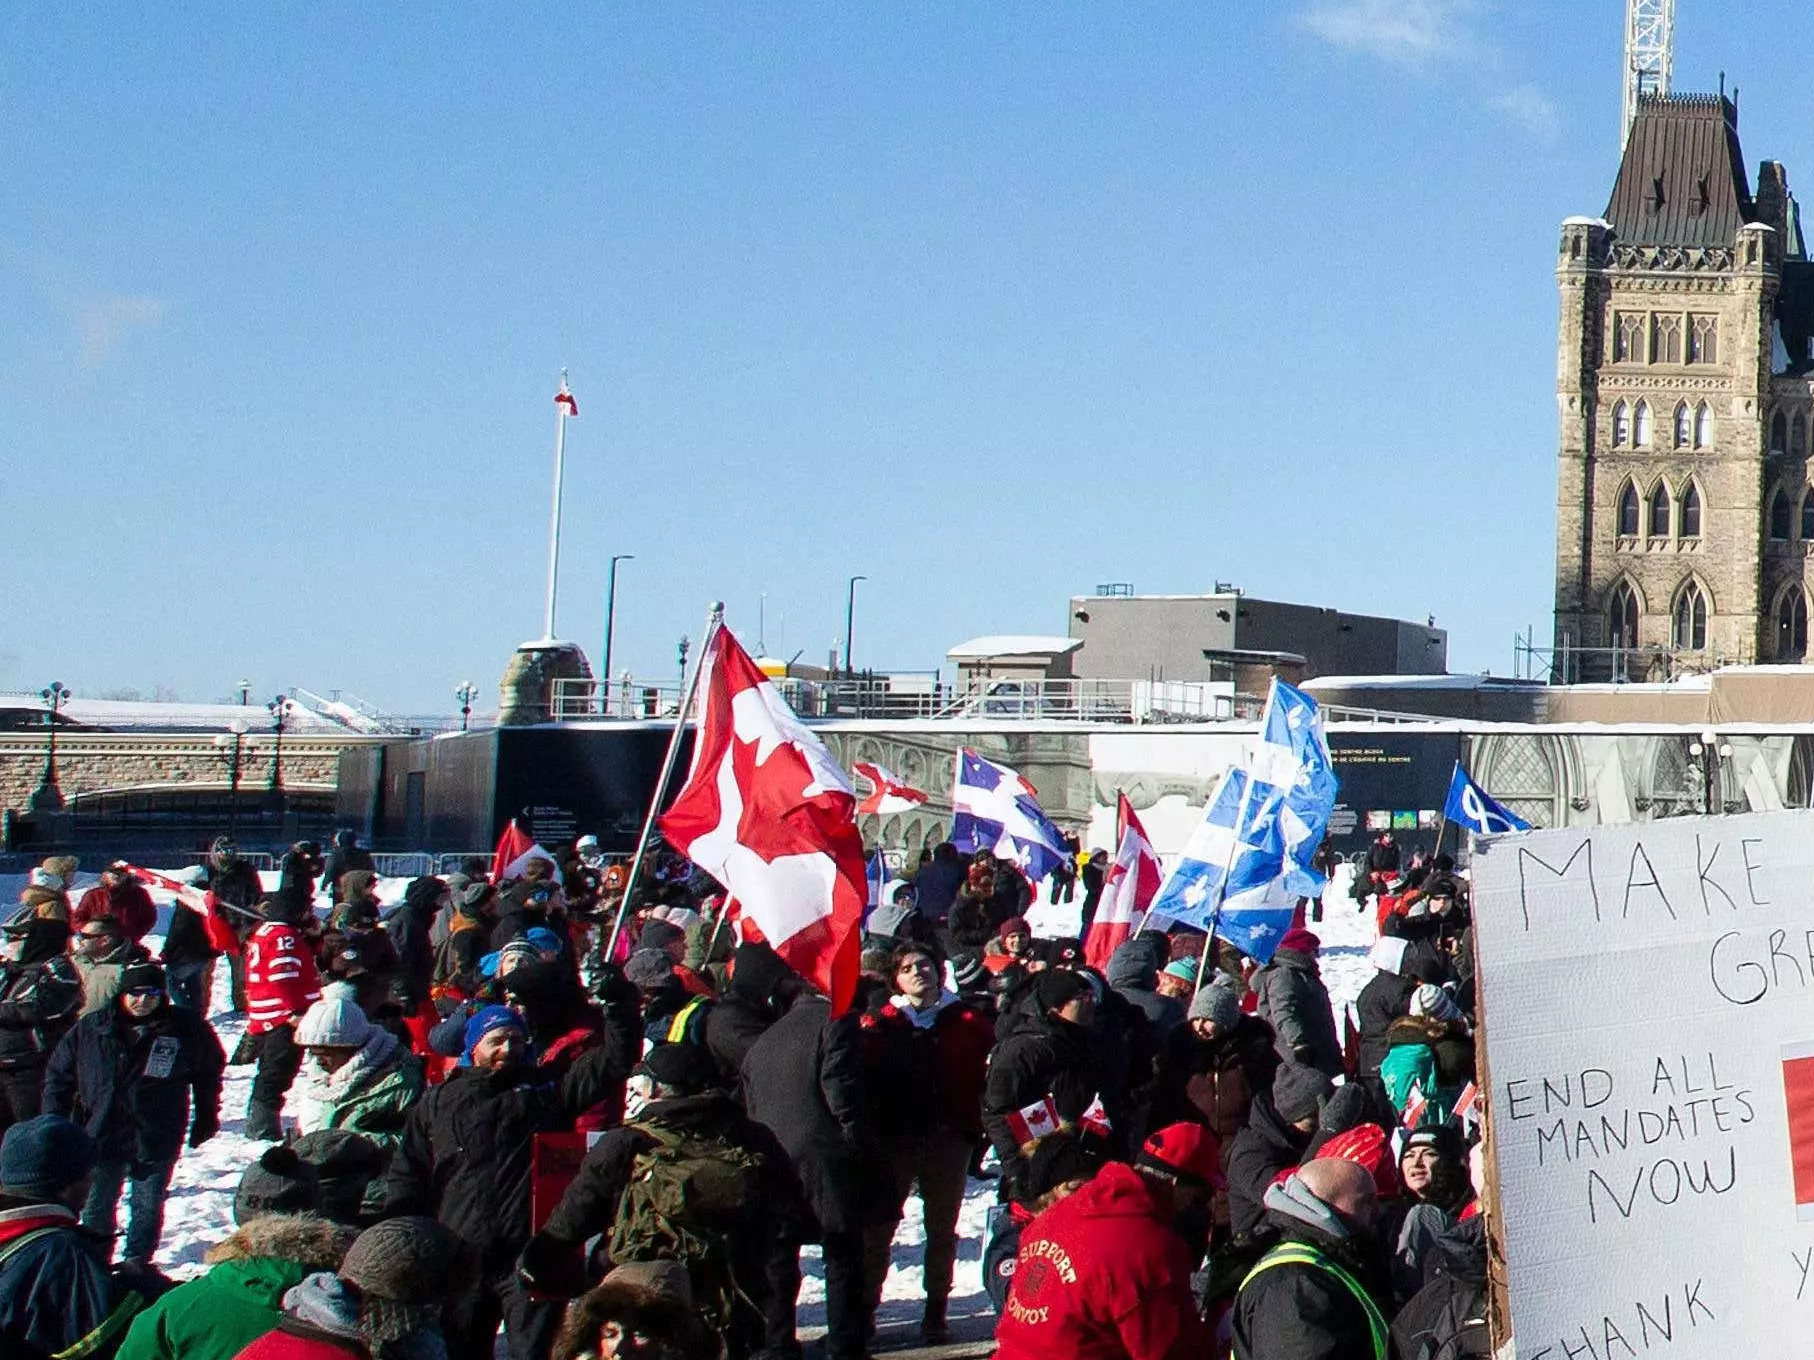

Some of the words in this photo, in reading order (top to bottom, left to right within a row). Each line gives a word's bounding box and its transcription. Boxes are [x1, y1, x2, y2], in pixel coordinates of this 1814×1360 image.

[1517, 832, 1769, 931] MAKE
[276, 936, 296, 951] 12
[1508, 1068, 1614, 1121] END
[1652, 1052, 1735, 1097] ALL
[1536, 1089, 1756, 1166] MANDATES
[1587, 1146, 1737, 1224] NOW
[1019, 1239, 1077, 1285] SUPPORT
[1007, 1291, 1050, 1326] ONVOY
